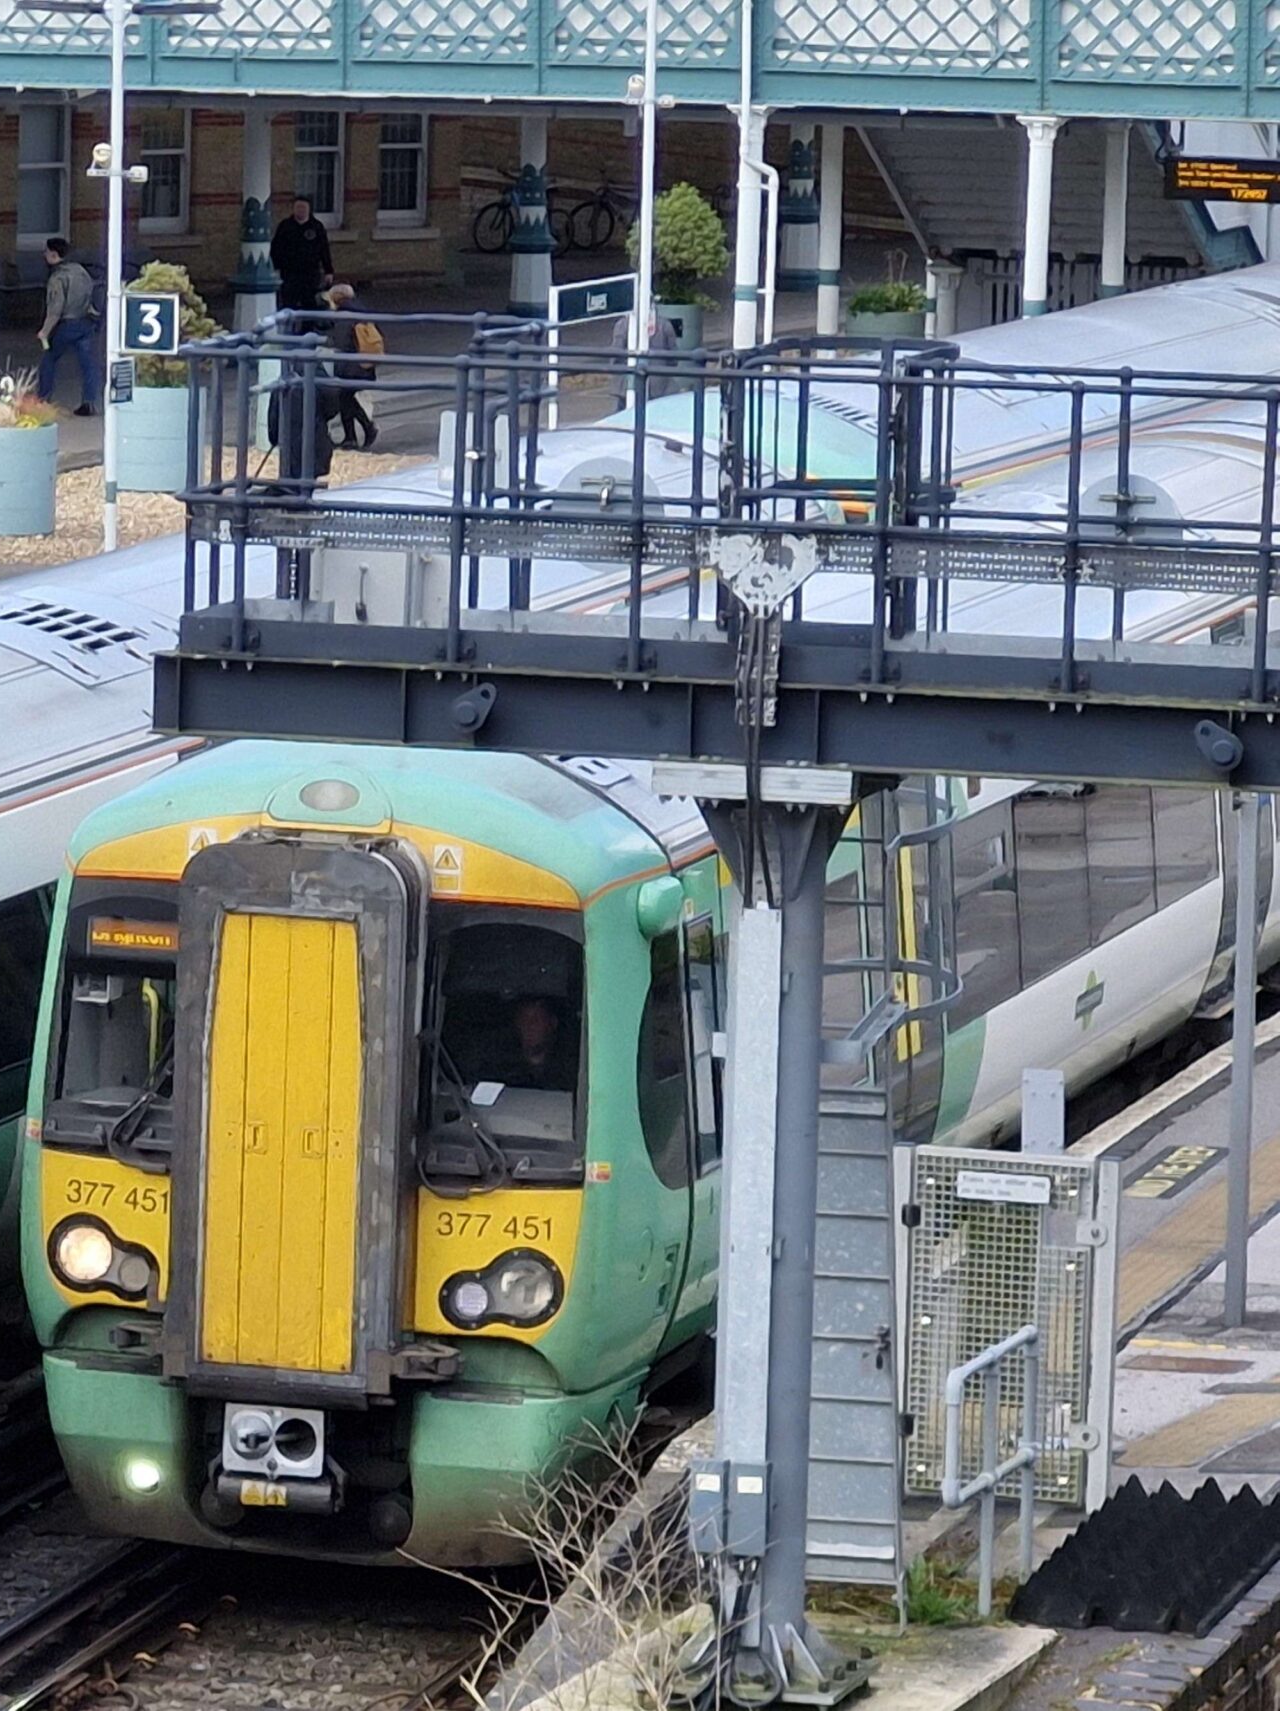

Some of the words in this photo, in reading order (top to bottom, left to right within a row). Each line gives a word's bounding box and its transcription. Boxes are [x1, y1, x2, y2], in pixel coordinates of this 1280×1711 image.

[138, 303, 162, 345] 3
[66, 1179, 116, 1208] 377
[124, 1187, 169, 1214] 451
[437, 1211, 492, 1238] 377
[503, 1215, 552, 1241] 451
